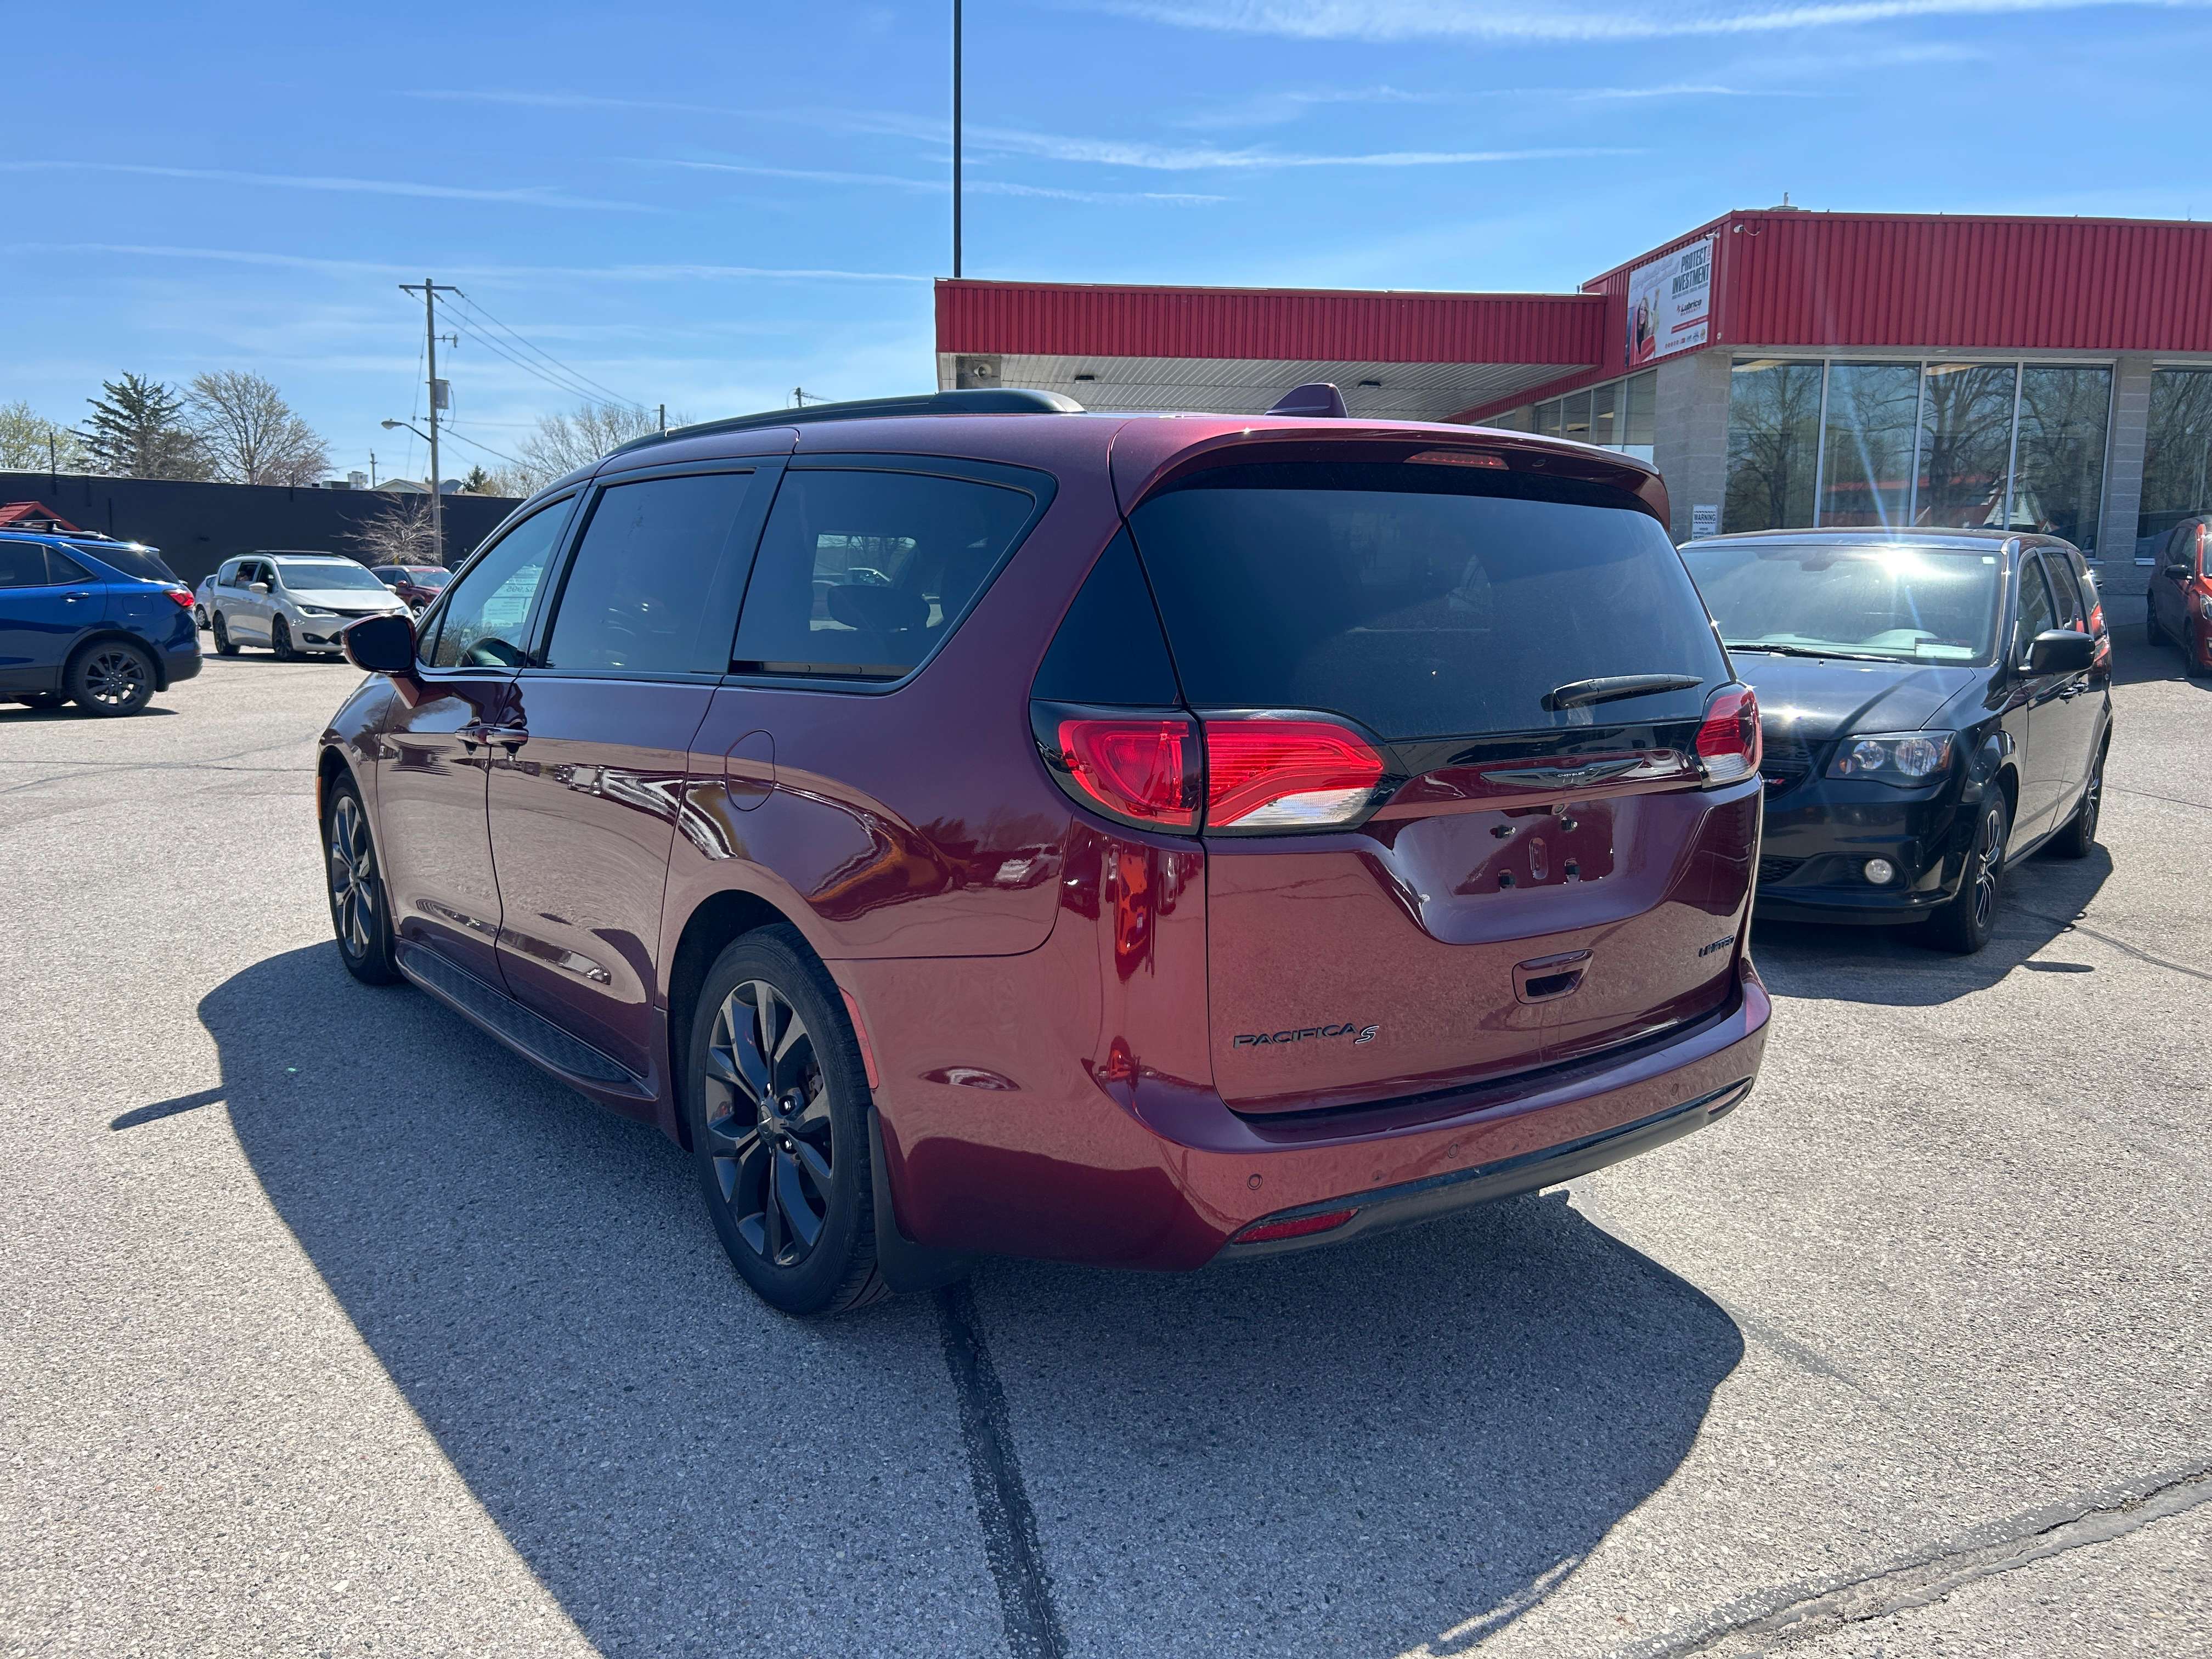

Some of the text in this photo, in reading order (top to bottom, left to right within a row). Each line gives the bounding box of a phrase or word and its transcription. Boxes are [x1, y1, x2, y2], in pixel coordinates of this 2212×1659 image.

[1681, 246, 1707, 273] PROTECT
[1672, 263, 1710, 295] INVESTMENT
[1681, 299, 1702, 312] Lubrico
[1233, 1023, 1380, 1048] PACIFICA S
